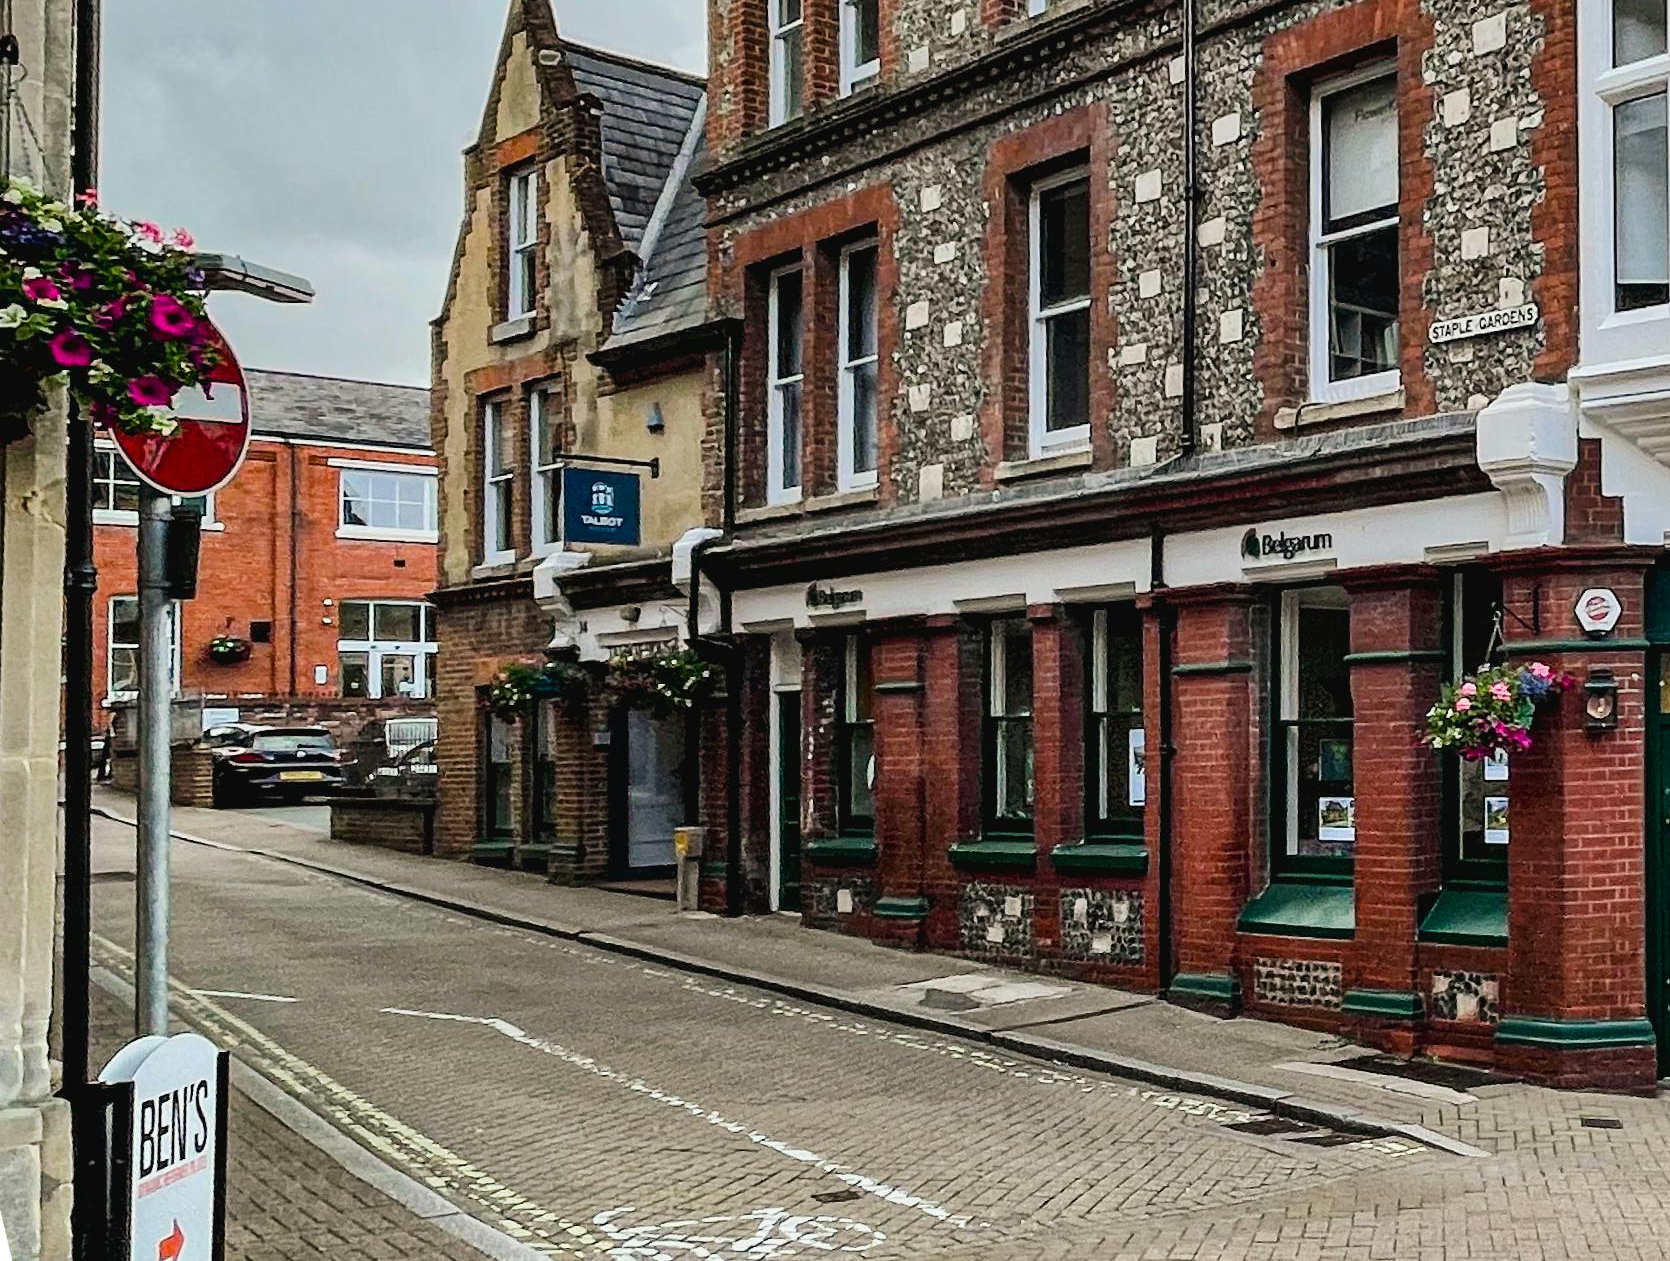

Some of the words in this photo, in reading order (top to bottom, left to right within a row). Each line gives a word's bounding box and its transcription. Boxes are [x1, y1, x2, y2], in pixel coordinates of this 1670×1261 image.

[1432, 319, 1473, 339] STAPLE
[1479, 307, 1534, 330] GARDENS
[580, 514, 624, 527] TALBOT
[1262, 531, 1332, 559] Belgarum
[140, 1079, 208, 1179] BEN'S
